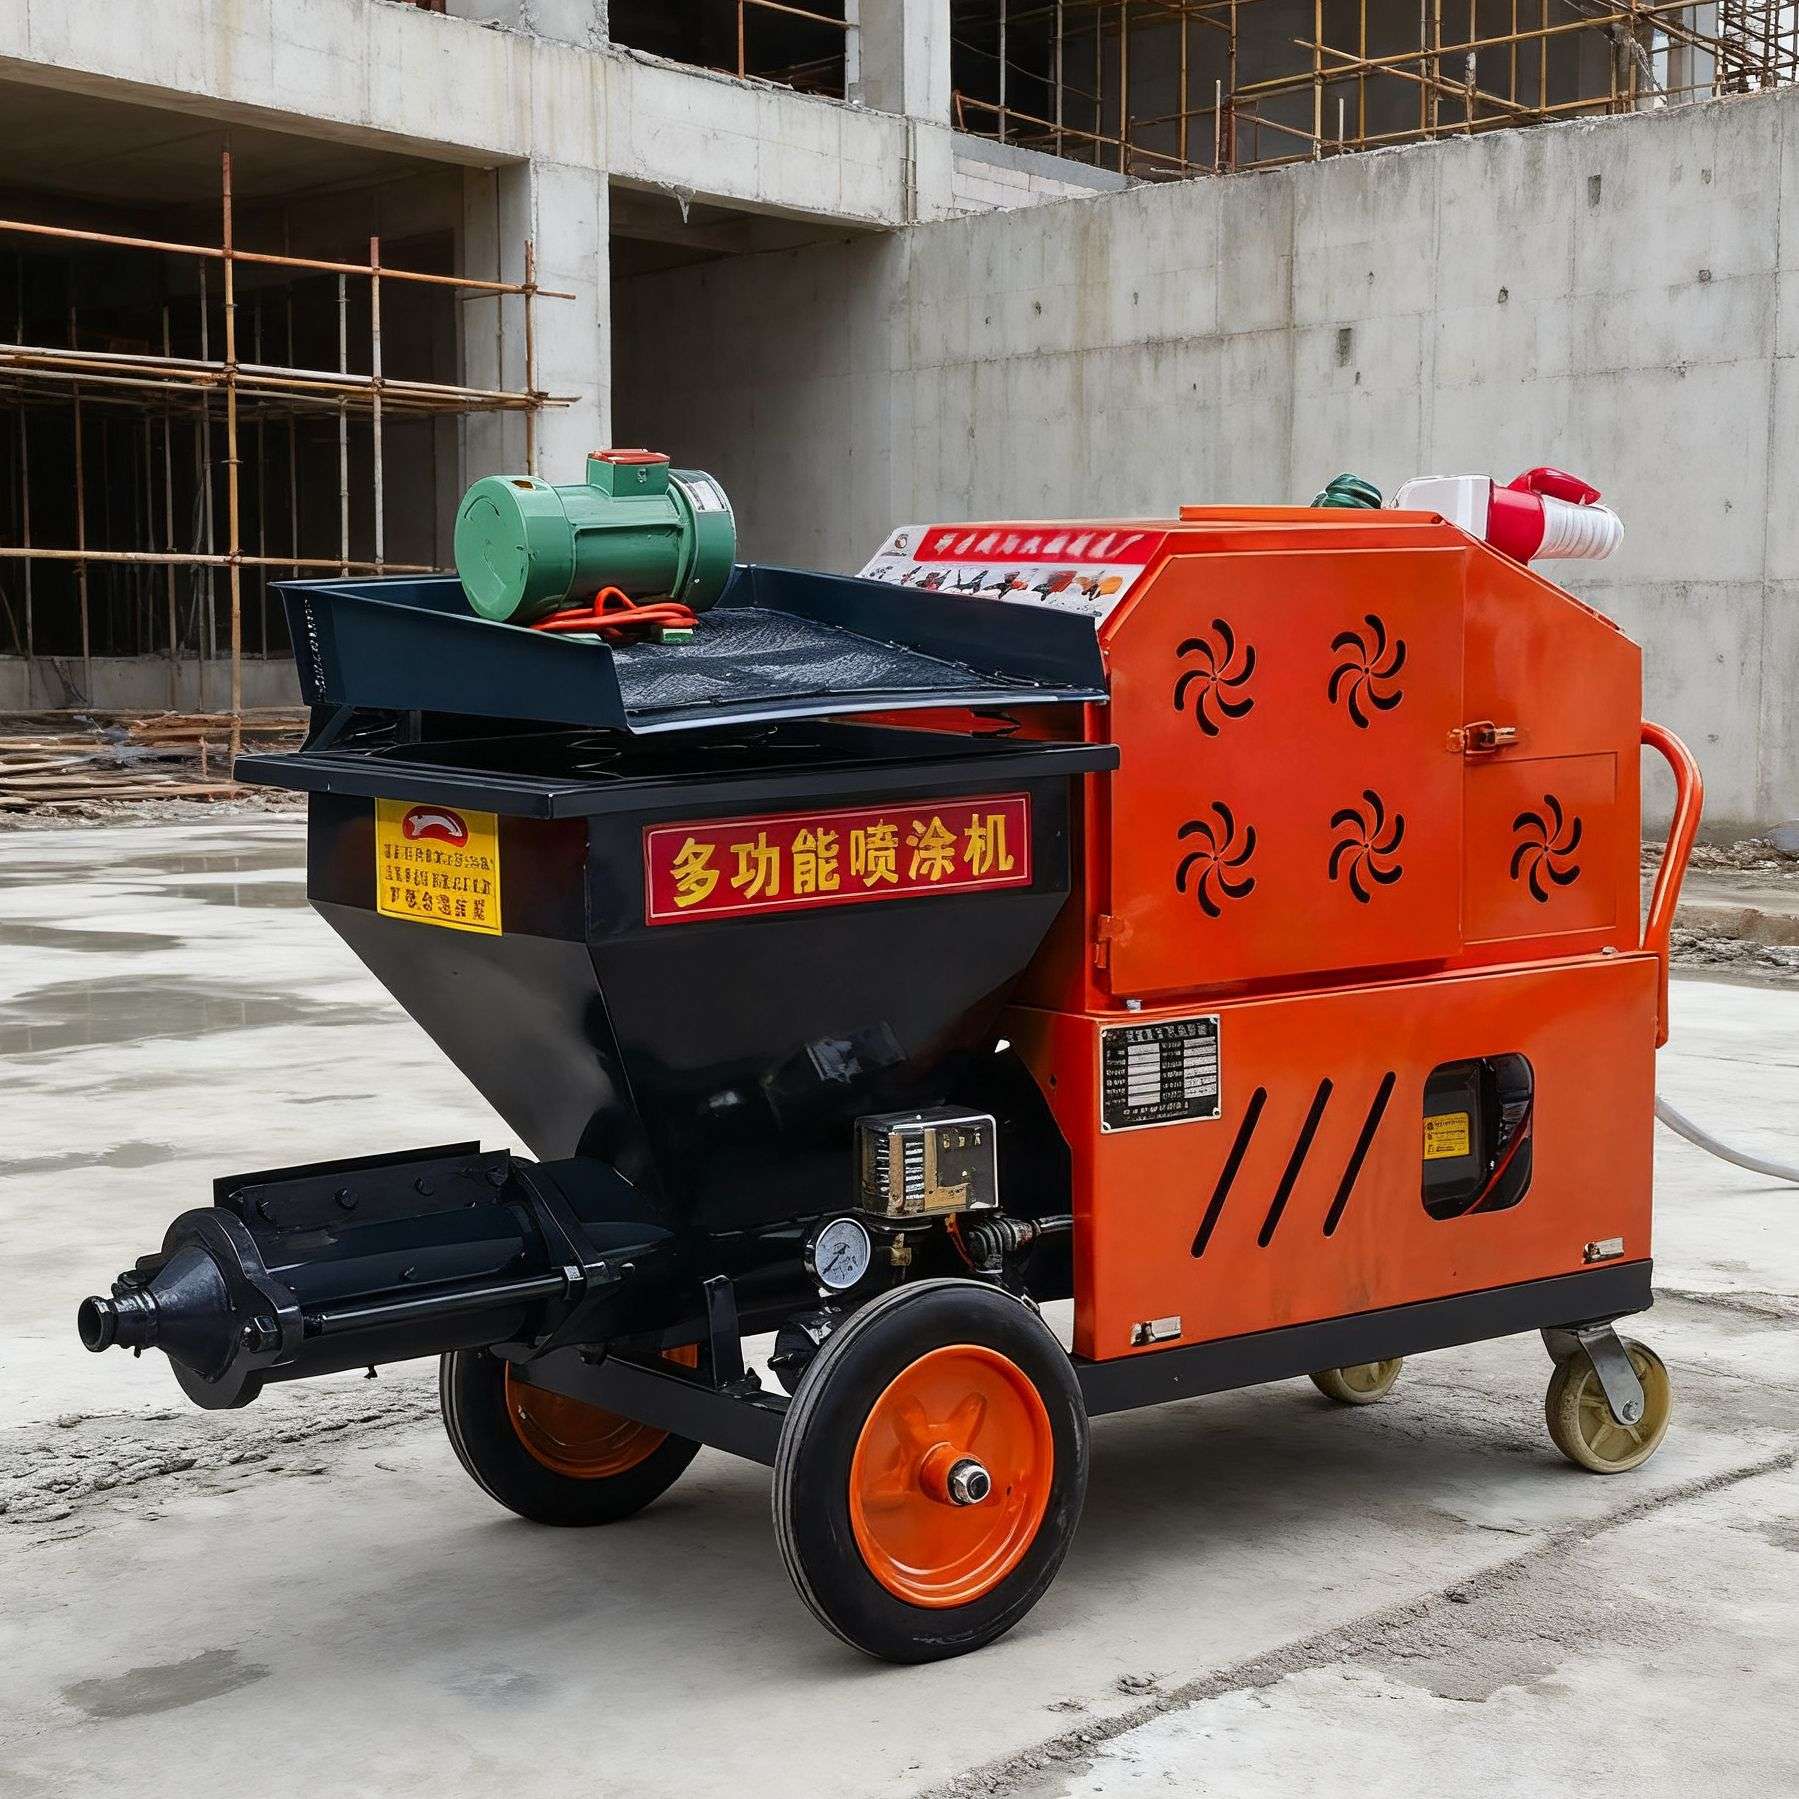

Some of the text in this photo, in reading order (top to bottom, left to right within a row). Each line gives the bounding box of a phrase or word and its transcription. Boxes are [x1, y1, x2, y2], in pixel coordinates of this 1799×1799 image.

[672, 813, 1014, 908] 多功能喷涂机
